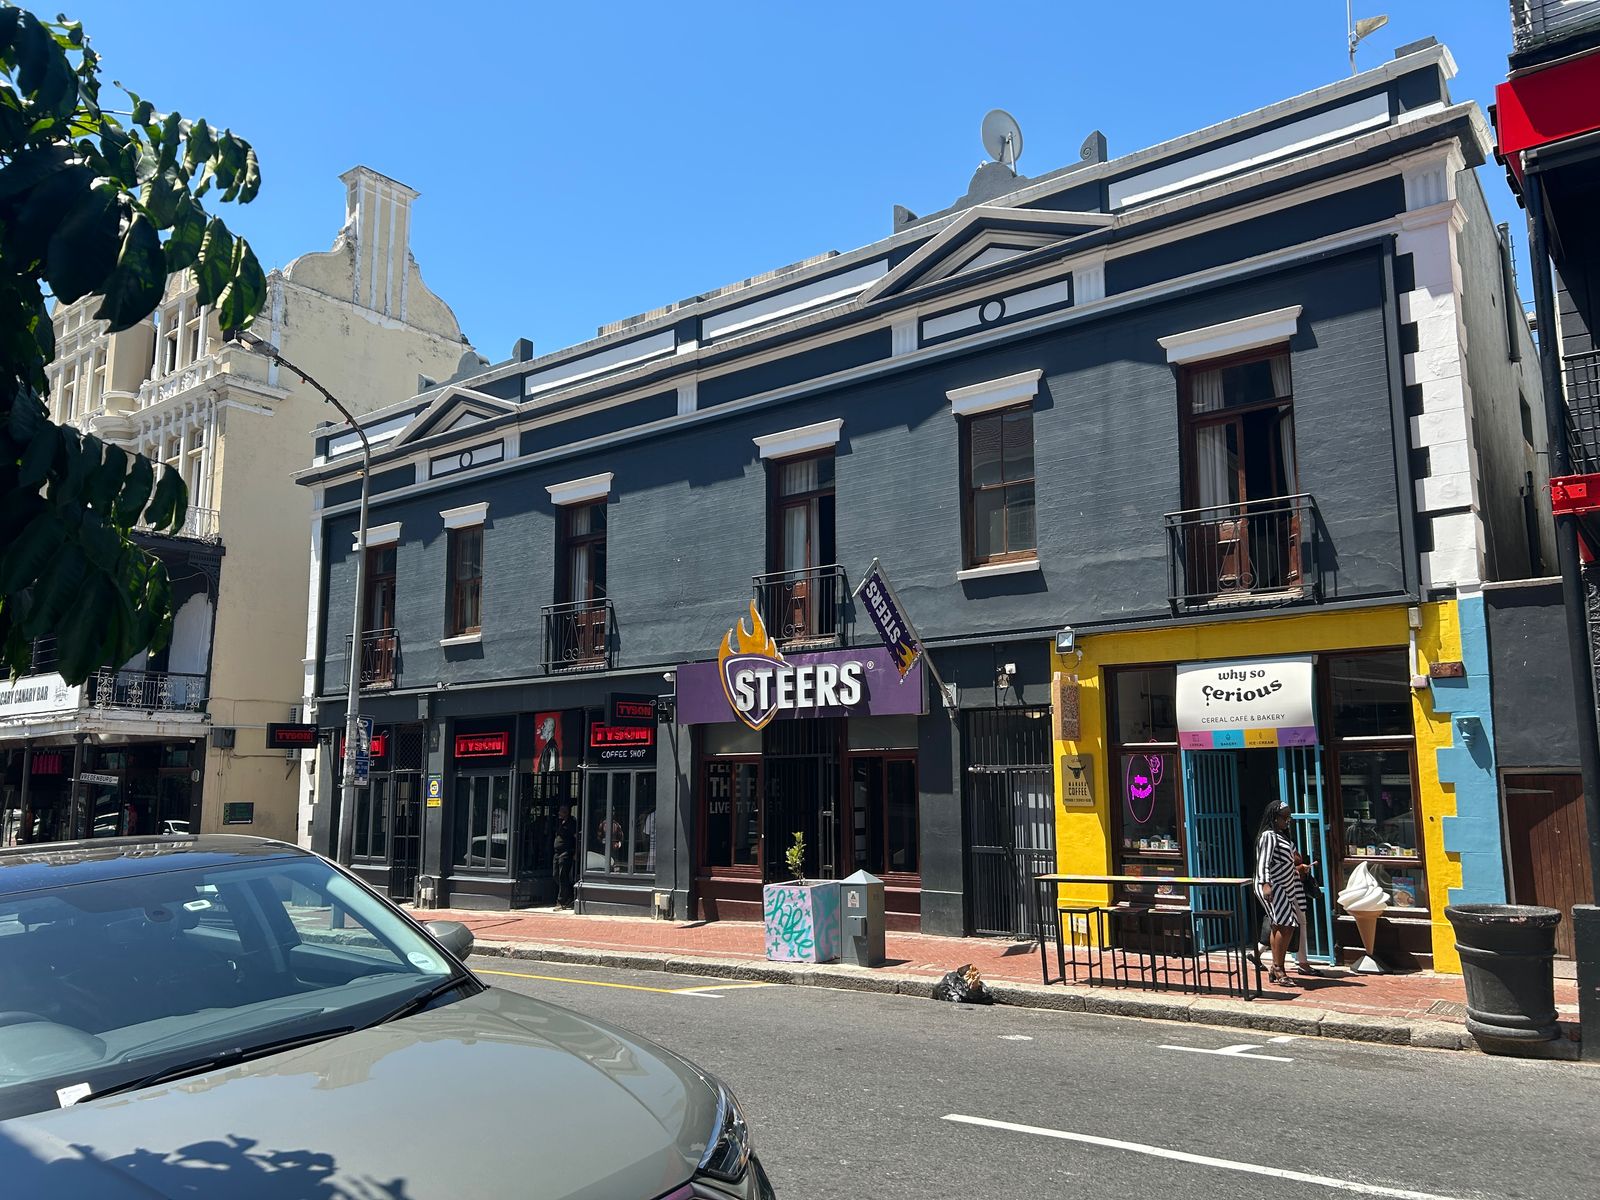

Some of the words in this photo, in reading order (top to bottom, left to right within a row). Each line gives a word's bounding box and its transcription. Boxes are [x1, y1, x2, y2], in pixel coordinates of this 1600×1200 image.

[865, 580, 901, 645] STEERS
[1218, 669, 1247, 681] why
[1249, 669, 1266, 679] so
[735, 661, 863, 712] STEERS
[14, 687, 37, 704] CANARY
[36, 685, 49, 702] BAR
[618, 704, 652, 716] TYSON
[1229, 715, 1248, 723] CAFE
[1256, 713, 1286, 721] BAKERY
[277, 732, 312, 740] TYSON
[594, 727, 648, 742] TYSON
[459, 737, 503, 753] TYSON
[601, 750, 628, 759] COFFEE
[629, 749, 646, 758] SHOP
[80, 773, 113, 783] VREDENBURG
[1068, 787, 1088, 796] COFFEE
[709, 801, 731, 814] LIVE
